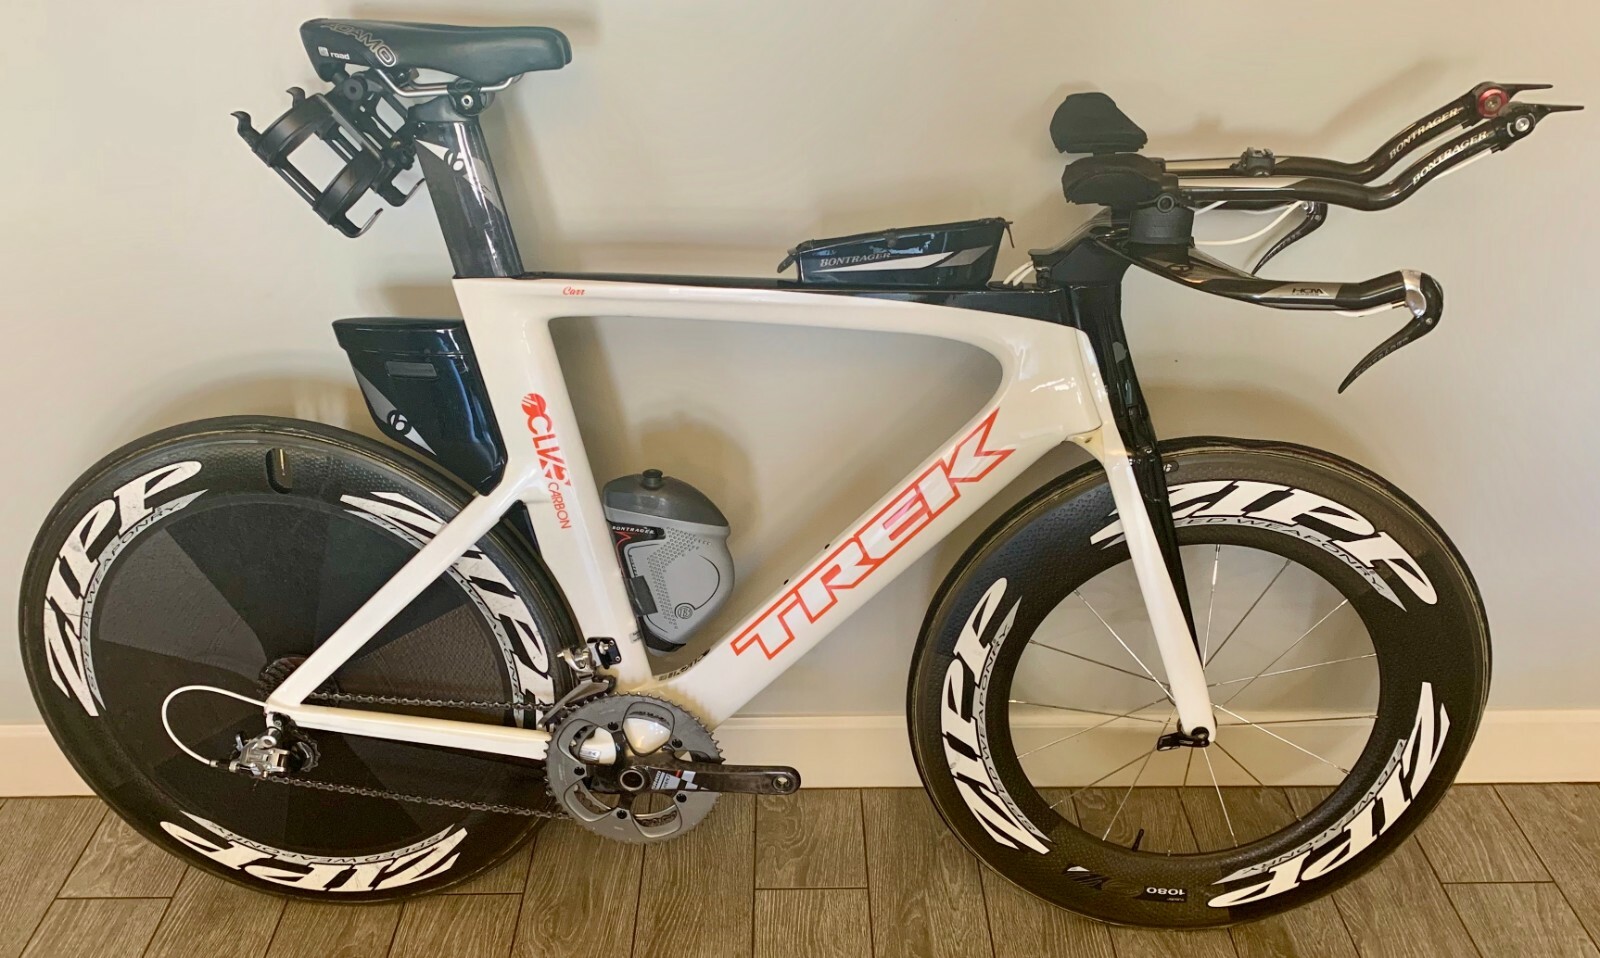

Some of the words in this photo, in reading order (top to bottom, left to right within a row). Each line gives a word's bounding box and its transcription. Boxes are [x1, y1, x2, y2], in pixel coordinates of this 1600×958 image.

[320, 24, 397, 67] ADAMO
[1389, 107, 1460, 160] BONTRAGER
[1412, 131, 1489, 185] BONTRAGER
[819, 252, 891, 267] BONTRAGER
[548, 482, 571, 529] CARBON
[730, 407, 1016, 660] TREK
[44, 461, 202, 716] ZIPP
[1237, 518, 1385, 590] WEAPONRY
[941, 577, 1050, 855] ZIPP
[977, 625, 1010, 765] WEAPONRY
[1207, 682, 1450, 908] ZIPP
[160, 821, 468, 891] ZIPP
[1242, 791, 1375, 876] WEAPONRY
[1146, 886, 1186, 896] 1080
